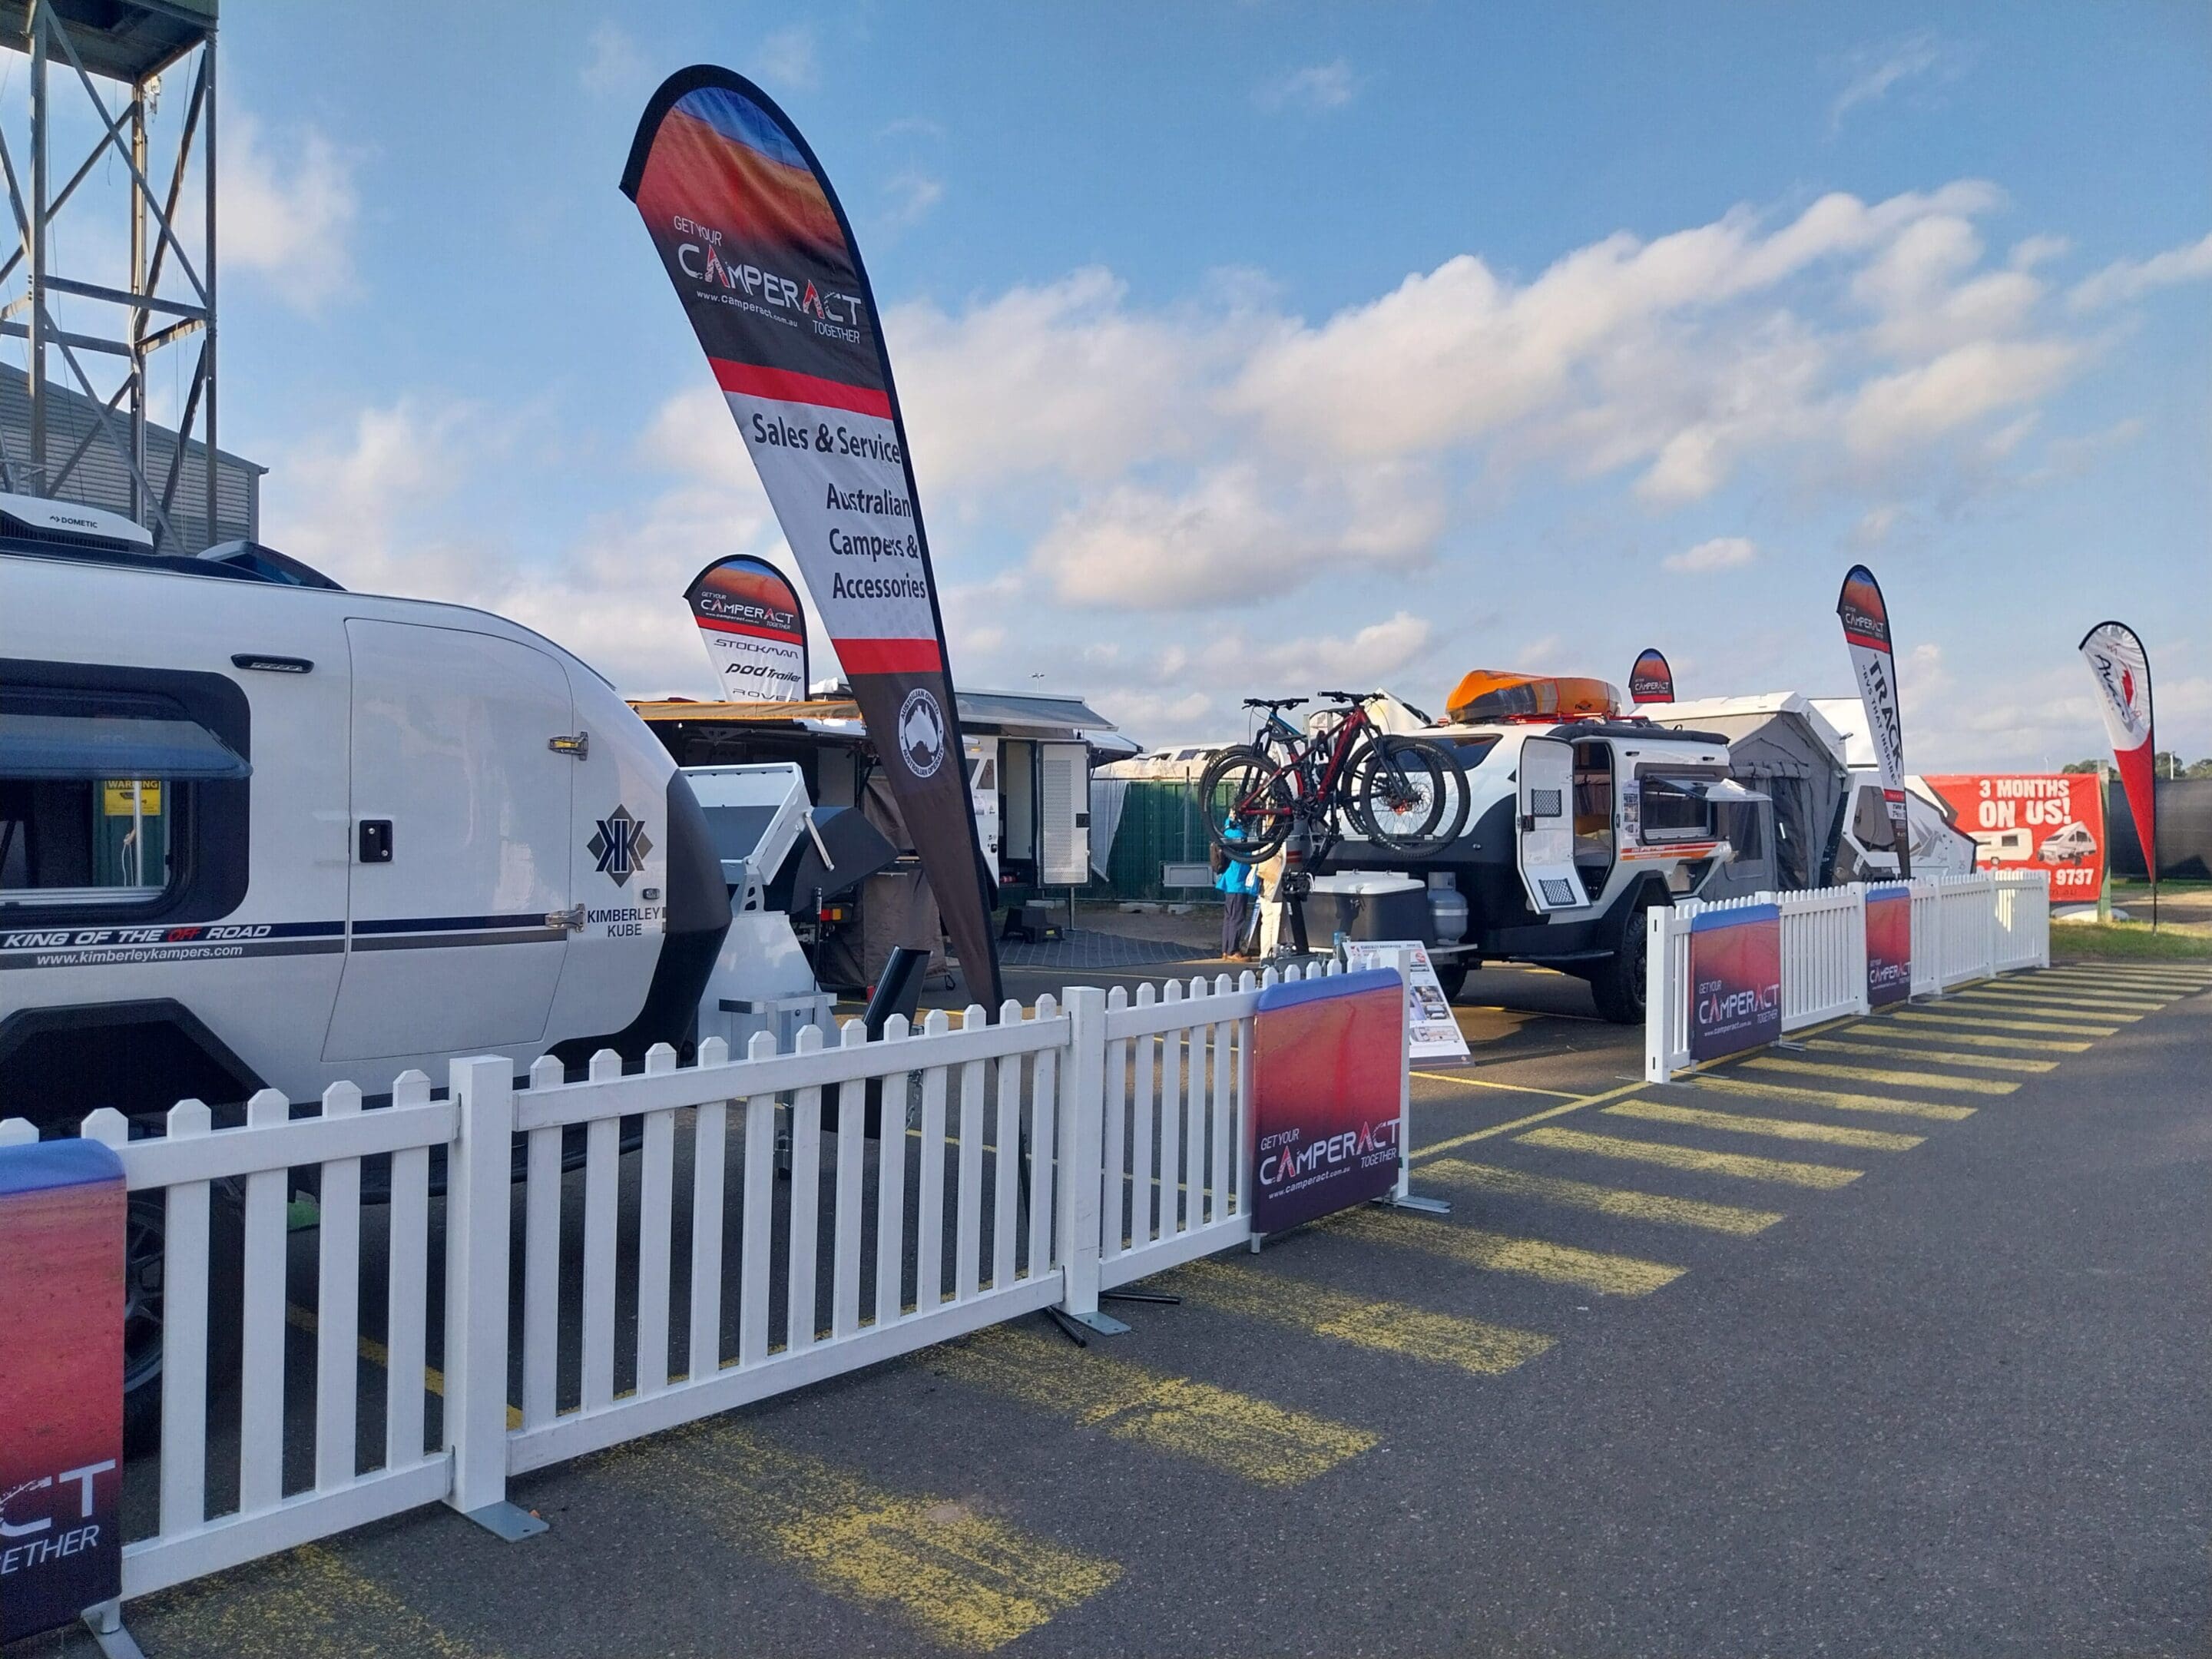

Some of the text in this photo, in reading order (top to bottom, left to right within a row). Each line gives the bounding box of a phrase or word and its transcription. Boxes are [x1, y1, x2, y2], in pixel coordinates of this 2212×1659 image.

[674, 216, 722, 246] GET YOUR
[678, 243, 861, 326] CAMPERACT
[697, 290, 798, 327] www.camperact.com.au
[813, 320, 860, 344] TOGETHER
[753, 412, 901, 464] Sales & Service
[826, 482, 912, 518] Australian
[61, 517, 98, 528] DOMETIC
[829, 528, 919, 562] Campers &
[833, 572, 926, 598] Accessories
[700, 599, 794, 624] CAMPERACT
[767, 621, 791, 630] TOGETHER
[714, 638, 799, 660] STOCKMAN
[900, 690, 925, 720] AUSTRALIAN
[108, 780, 159, 789] WARNG
[1979, 779, 2070, 798] 3 MONTHS
[1979, 796, 2072, 828] ON US!
[2055, 869, 2094, 886] 9737
[587, 907, 661, 923] KIMBERLEY
[4, 926, 271, 947] KING OF THE OFF ROAD
[608, 924, 642, 938] KUBE
[38, 945, 243, 965] www.kimberleykampers.com
[1699, 983, 1780, 1024] CAMPERACT
[1260, 1128, 1300, 1151] GET YOUR
[1260, 1118, 1400, 1185] CAMPERACT
[1361, 1147, 1396, 1168] TOGETHER
[1269, 1166, 1351, 1199] www.camperact.com.au
[0, 1525, 100, 1575] ETHER
